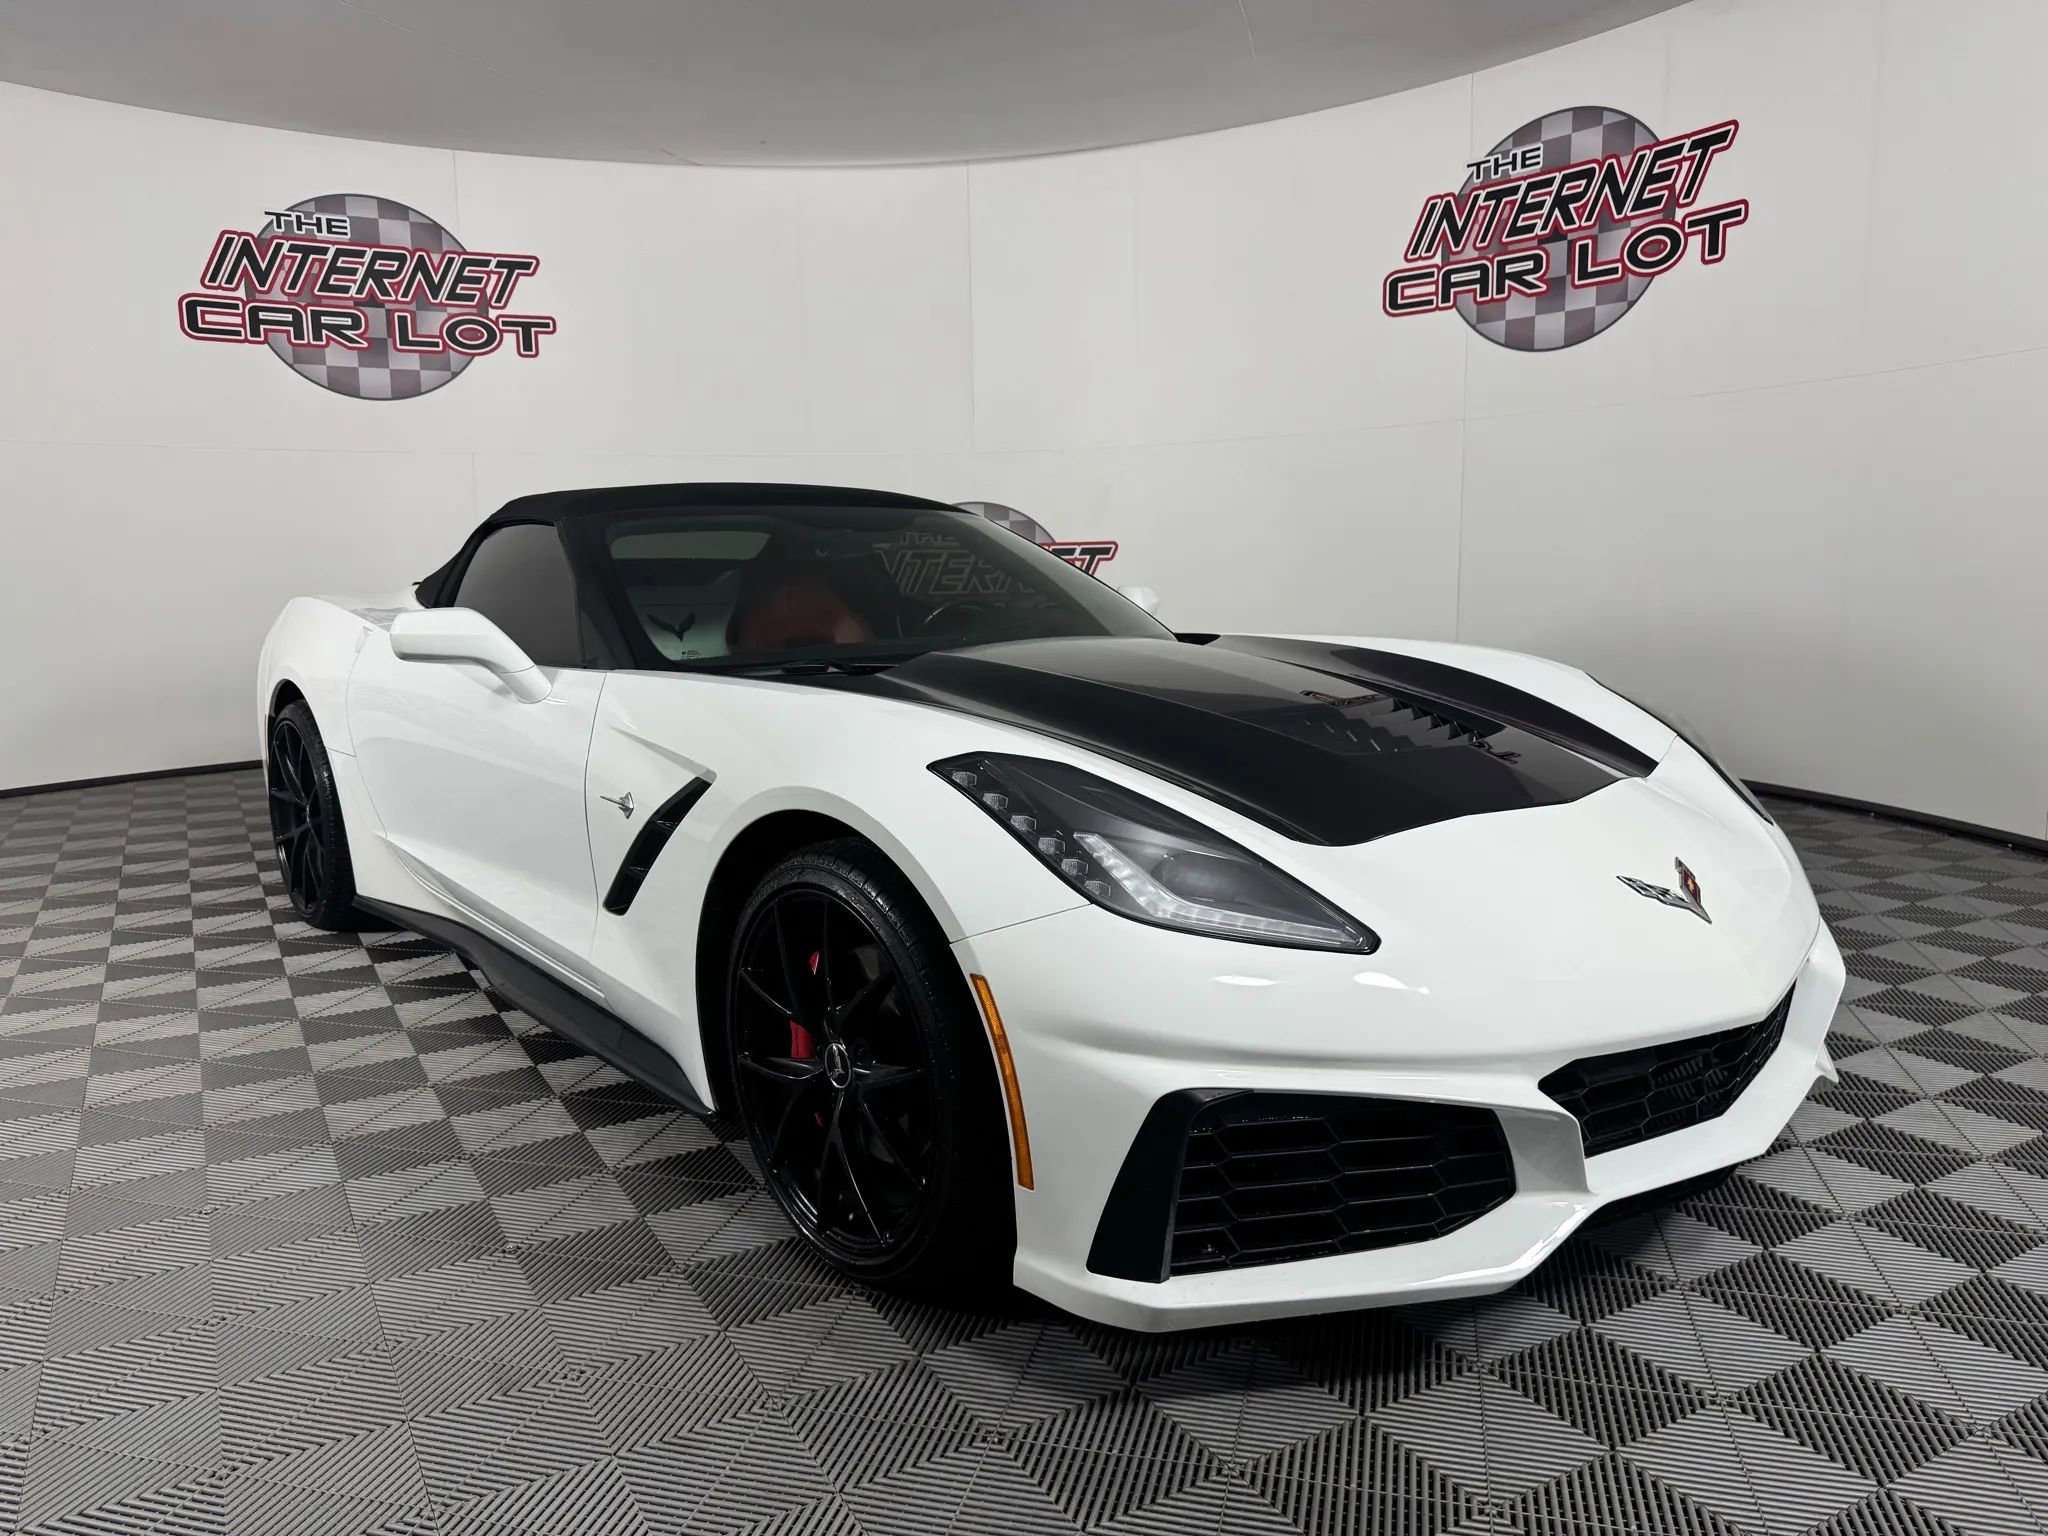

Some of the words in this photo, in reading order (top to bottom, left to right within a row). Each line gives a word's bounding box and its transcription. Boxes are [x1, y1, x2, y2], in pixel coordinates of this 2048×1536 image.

[1406, 122, 1737, 260] INTERNET
[1466, 144, 1543, 182] THE
[262, 208, 351, 238] THE
[202, 233, 537, 306] INTERNET
[1386, 249, 1548, 314] CAR
[1574, 203, 1746, 286] LOT
[181, 296, 370, 349] CAR
[396, 311, 554, 356] LOT
